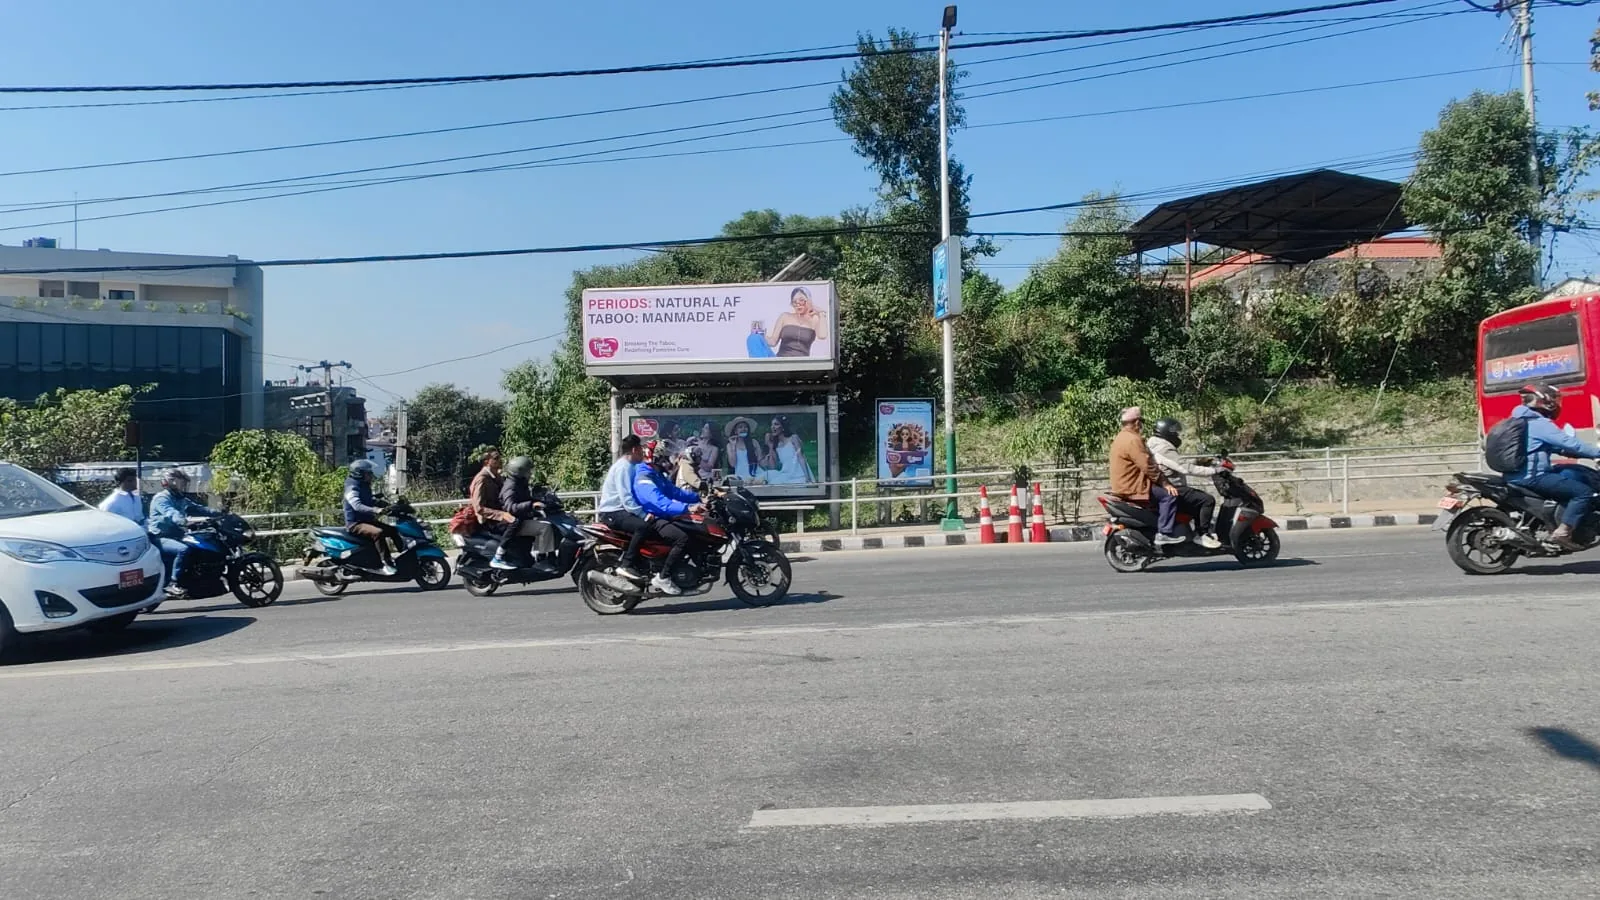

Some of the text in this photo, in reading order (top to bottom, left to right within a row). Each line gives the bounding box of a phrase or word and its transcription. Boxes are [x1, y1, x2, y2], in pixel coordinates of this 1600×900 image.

[588, 296, 741, 310] PERIODS: NATURAL AF
[588, 311, 736, 324] TABOO: MANMADE AF
